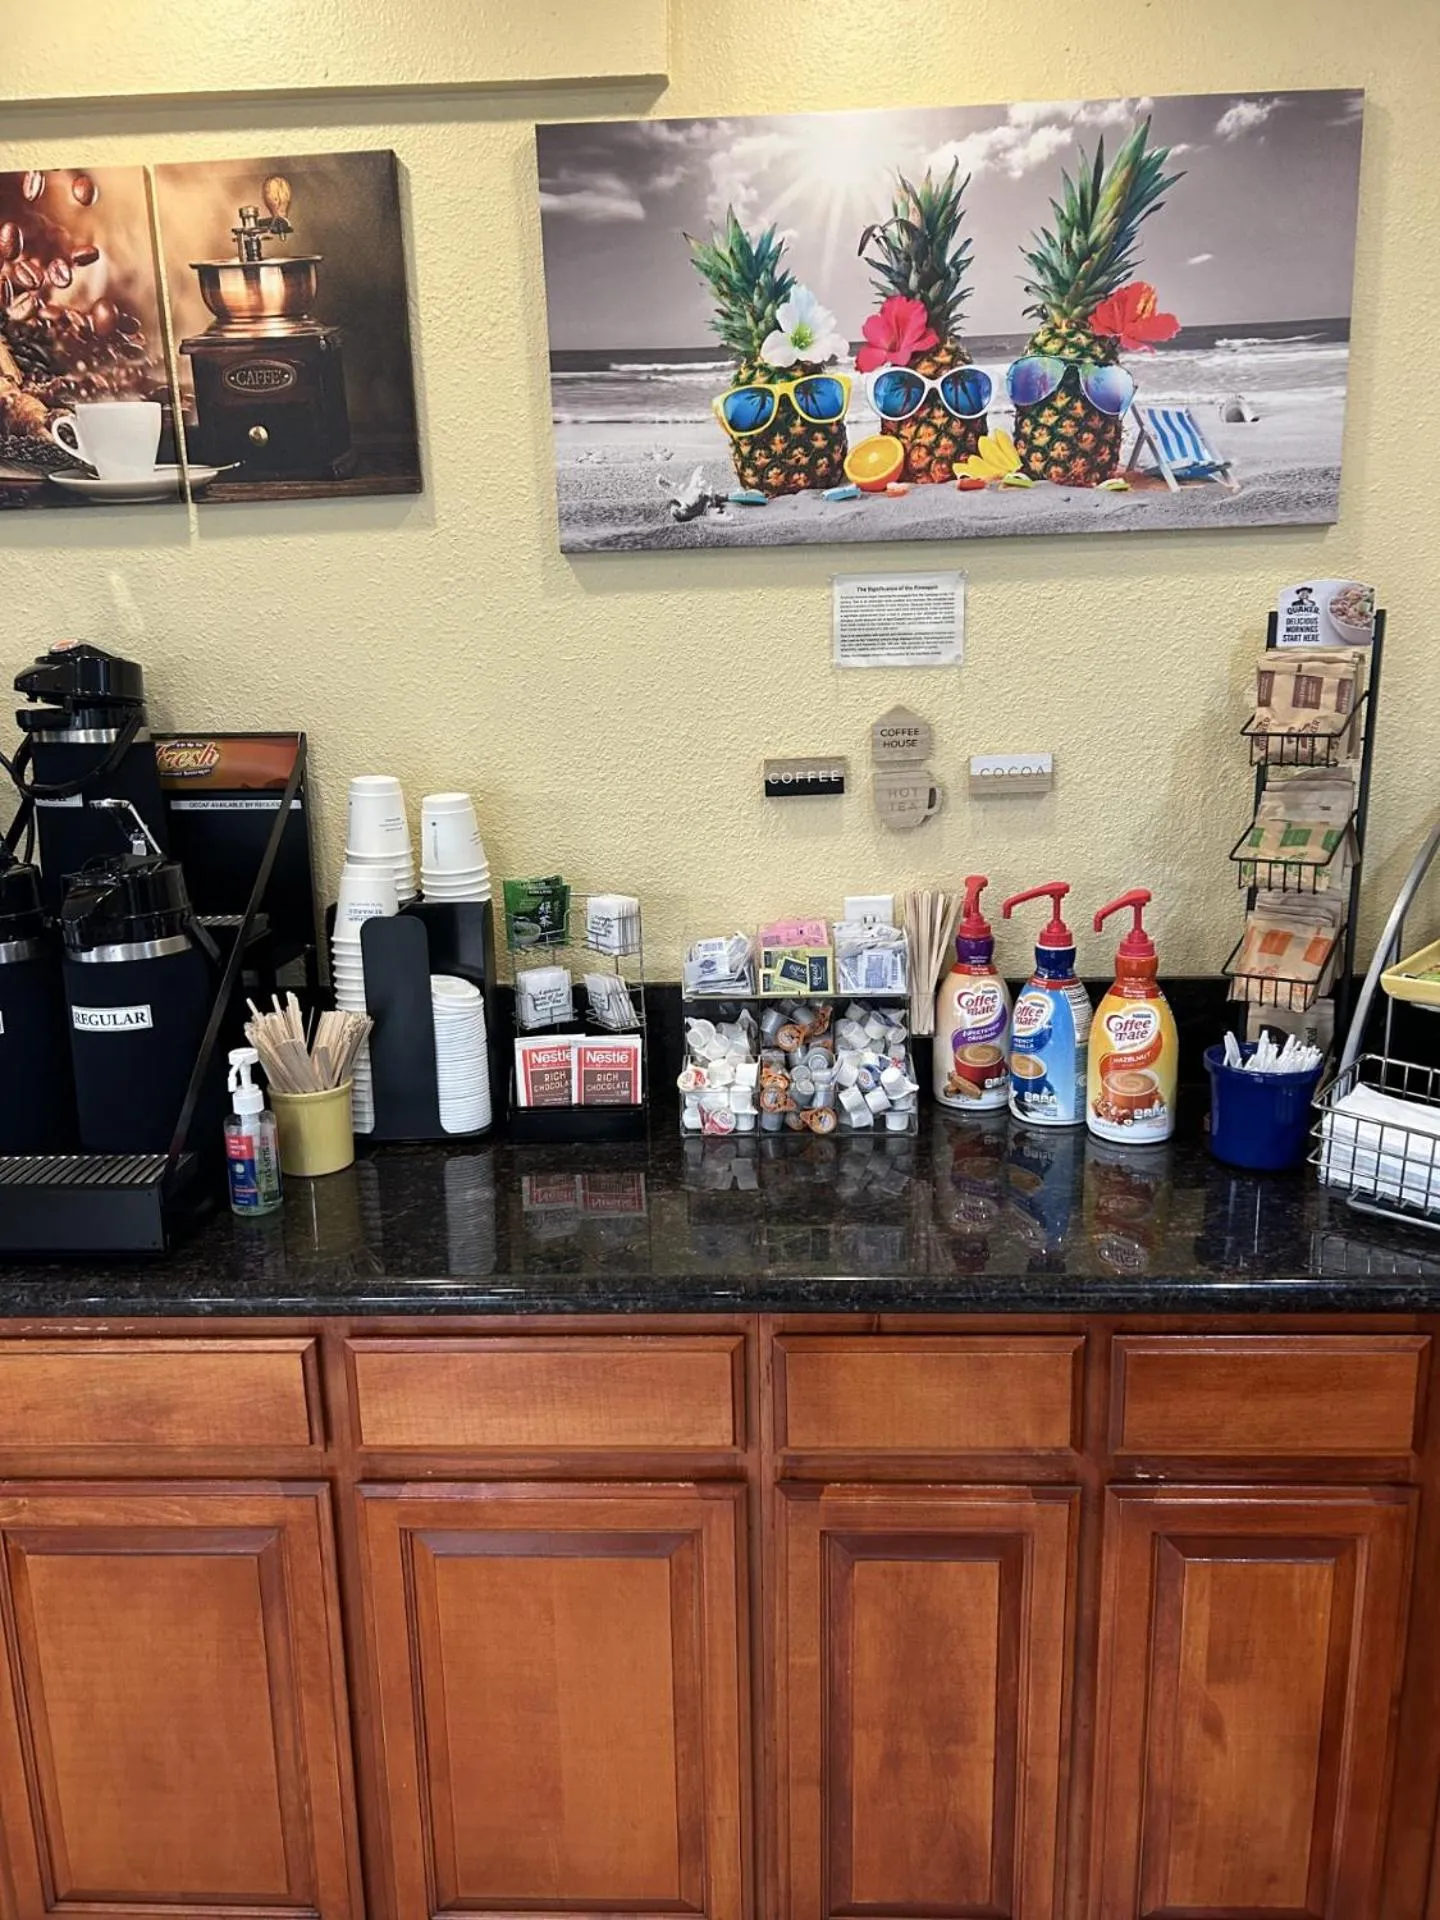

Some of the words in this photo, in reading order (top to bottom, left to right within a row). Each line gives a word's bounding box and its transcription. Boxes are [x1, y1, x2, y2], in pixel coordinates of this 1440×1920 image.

[1287, 606, 1320, 615] QUAKER
[1285, 617, 1319, 625] DELICIOUS
[1285, 625, 1319, 633] MORNINGS
[1282, 634, 1302, 642] START
[1302, 633, 1320, 642] HERE
[880, 727, 920, 738] COFFEE
[882, 739, 919, 749] HOUSE
[768, 769, 841, 785] COFFEE
[980, 765, 1045, 779] COCOA
[888, 787, 918, 799] HOT
[957, 991, 998, 1010] Coffee
[967, 1004, 996, 1017] mate
[74, 1011, 148, 1026] REGULAR
[1106, 1014, 1152, 1033] Coffee
[1115, 1029, 1149, 1042] mate
[544, 1071, 566, 1082] RICH
[597, 1072, 619, 1082] RICH
[533, 1080, 569, 1093] CHOCOLA
[585, 1081, 630, 1091] CHOCOLATE
